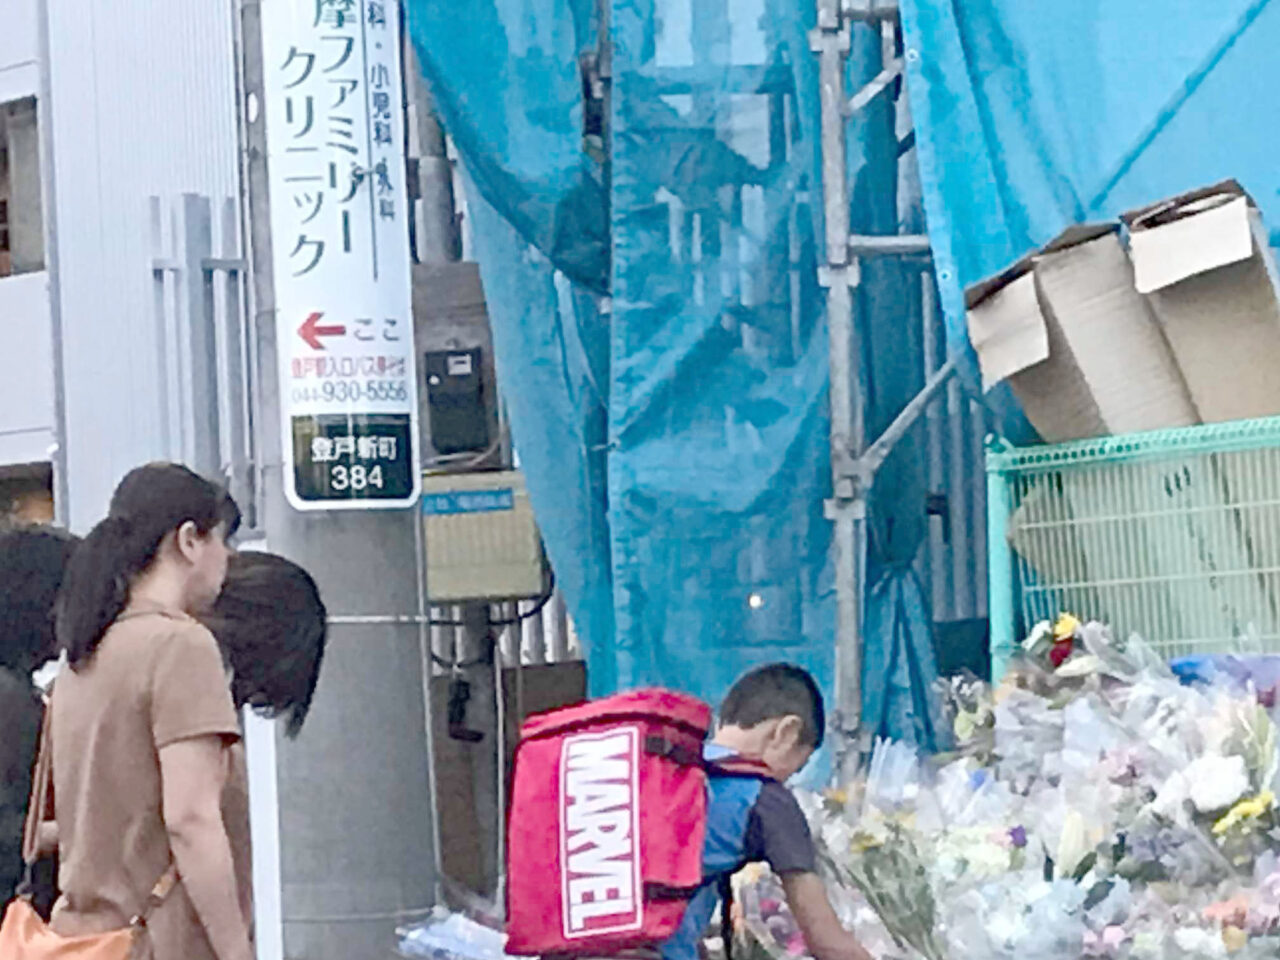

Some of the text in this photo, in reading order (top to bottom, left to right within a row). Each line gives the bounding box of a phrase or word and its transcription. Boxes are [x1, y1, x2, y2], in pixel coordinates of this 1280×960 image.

[280, 45, 326, 278] クリニック
[353, 317, 401, 341] ここ
[311, 436, 397, 462] 登戸新町
[331, 464, 384, 491] 384
[566, 735, 635, 932] MARVEL
